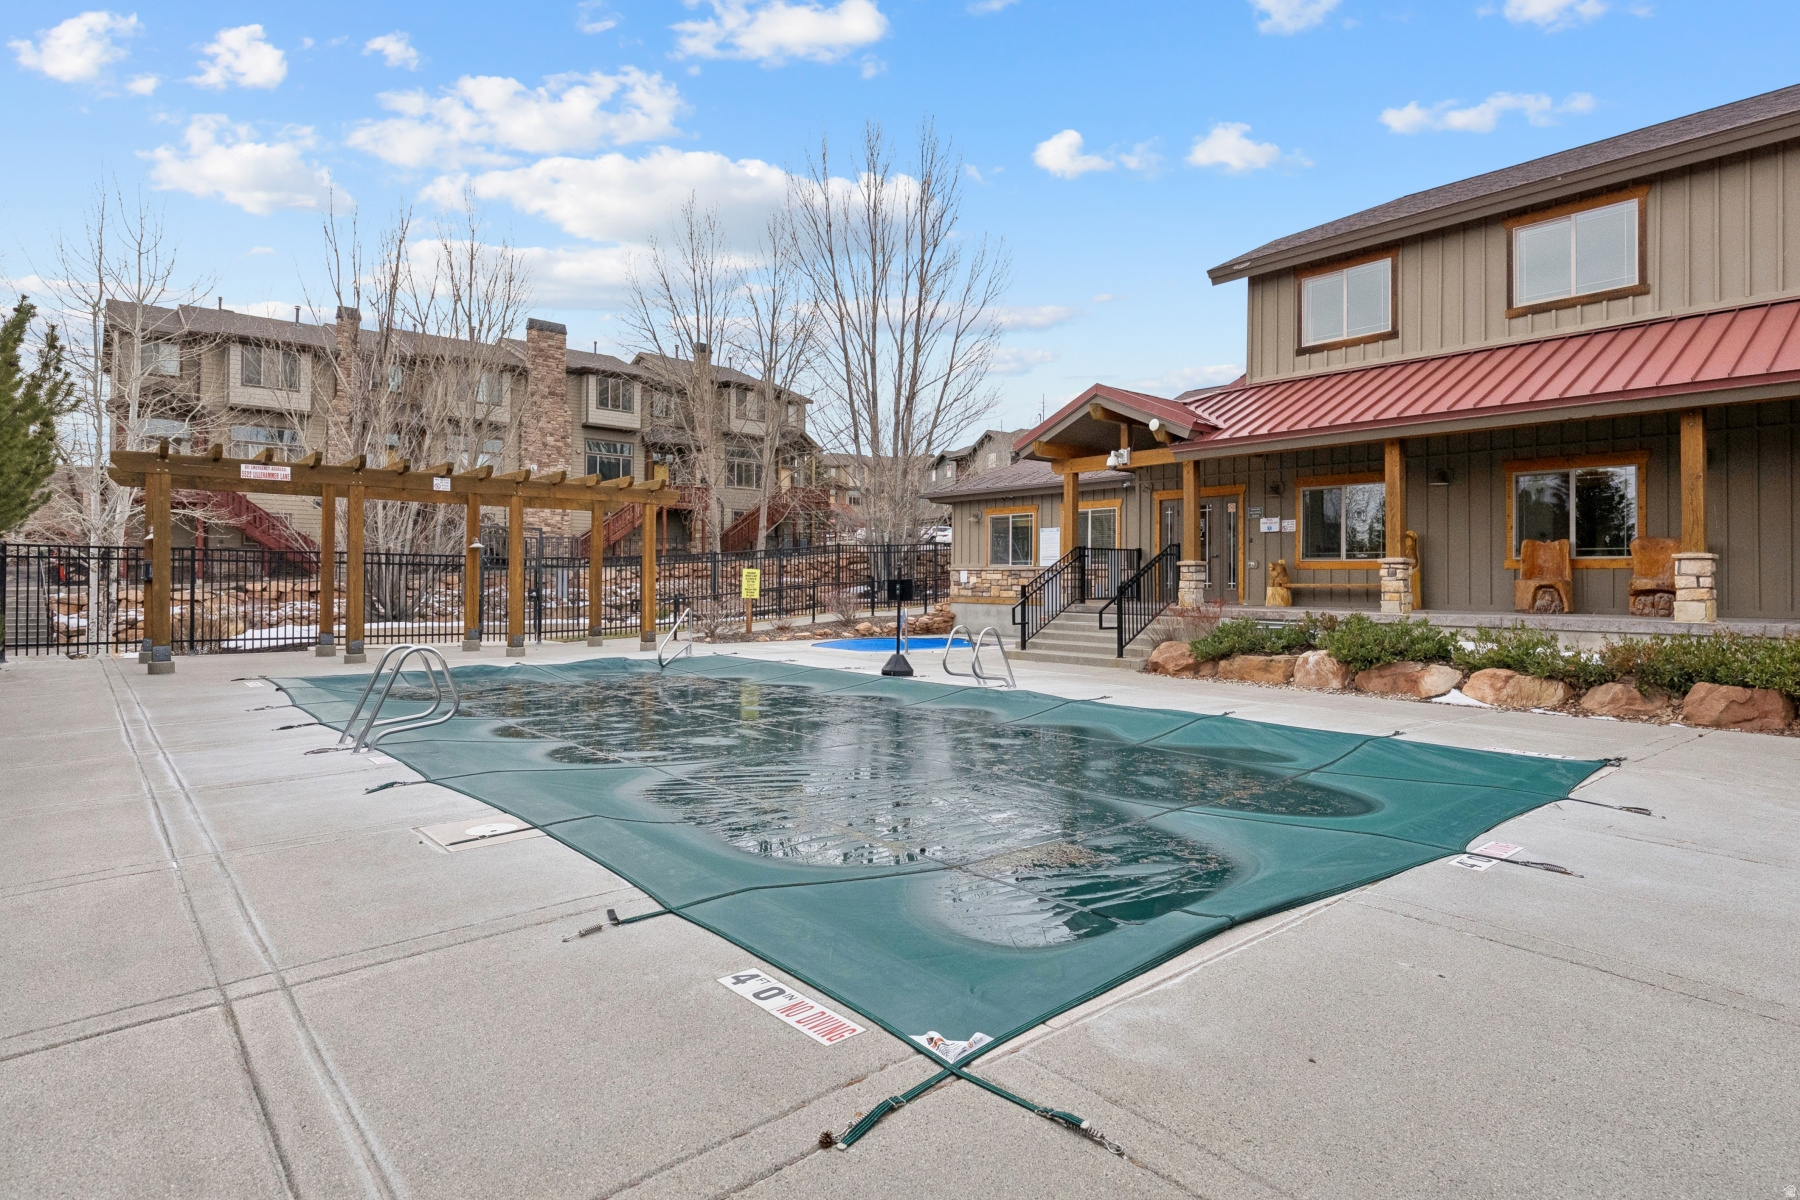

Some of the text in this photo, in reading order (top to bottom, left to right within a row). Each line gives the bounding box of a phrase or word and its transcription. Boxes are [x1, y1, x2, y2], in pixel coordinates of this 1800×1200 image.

[731, 974, 760, 986] 4
[752, 986, 786, 1000] 0
[782, 993, 798, 1001] IN
[776, 1000, 814, 1017] NO
[795, 1010, 857, 1042] DIVING
